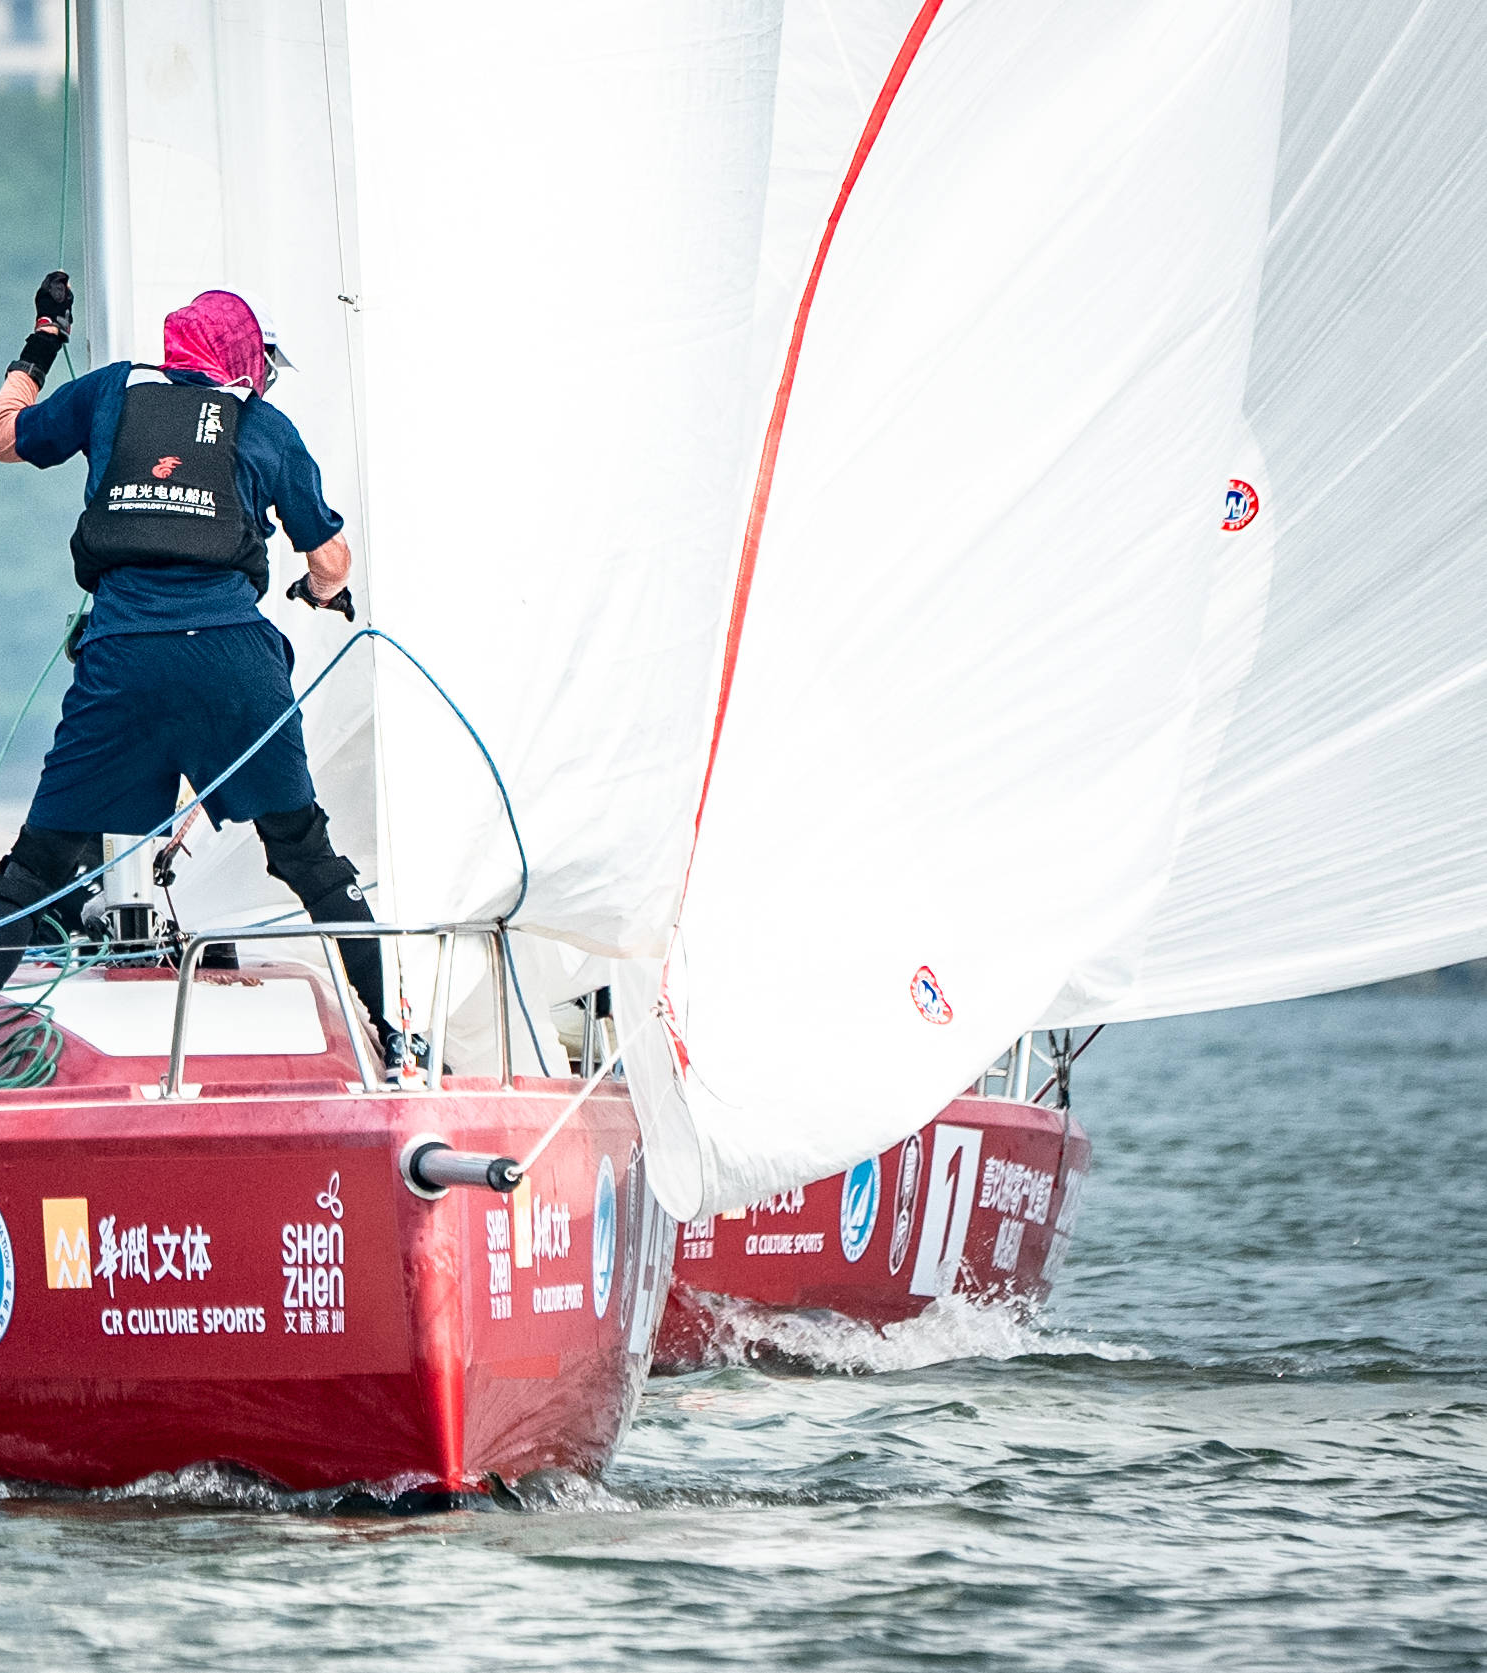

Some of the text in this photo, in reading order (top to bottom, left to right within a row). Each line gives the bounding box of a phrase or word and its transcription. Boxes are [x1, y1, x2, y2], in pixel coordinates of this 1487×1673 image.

[109, 484, 216, 506] 中麒光电帆船队
[745, 1232, 826, 1256] CR CULTURE SPORTS
[564, 1284, 584, 1311] SPORTS
[101, 1306, 267, 1335] CR CULTURE SPORTS
[284, 1310, 345, 1335] 文旅深圳
